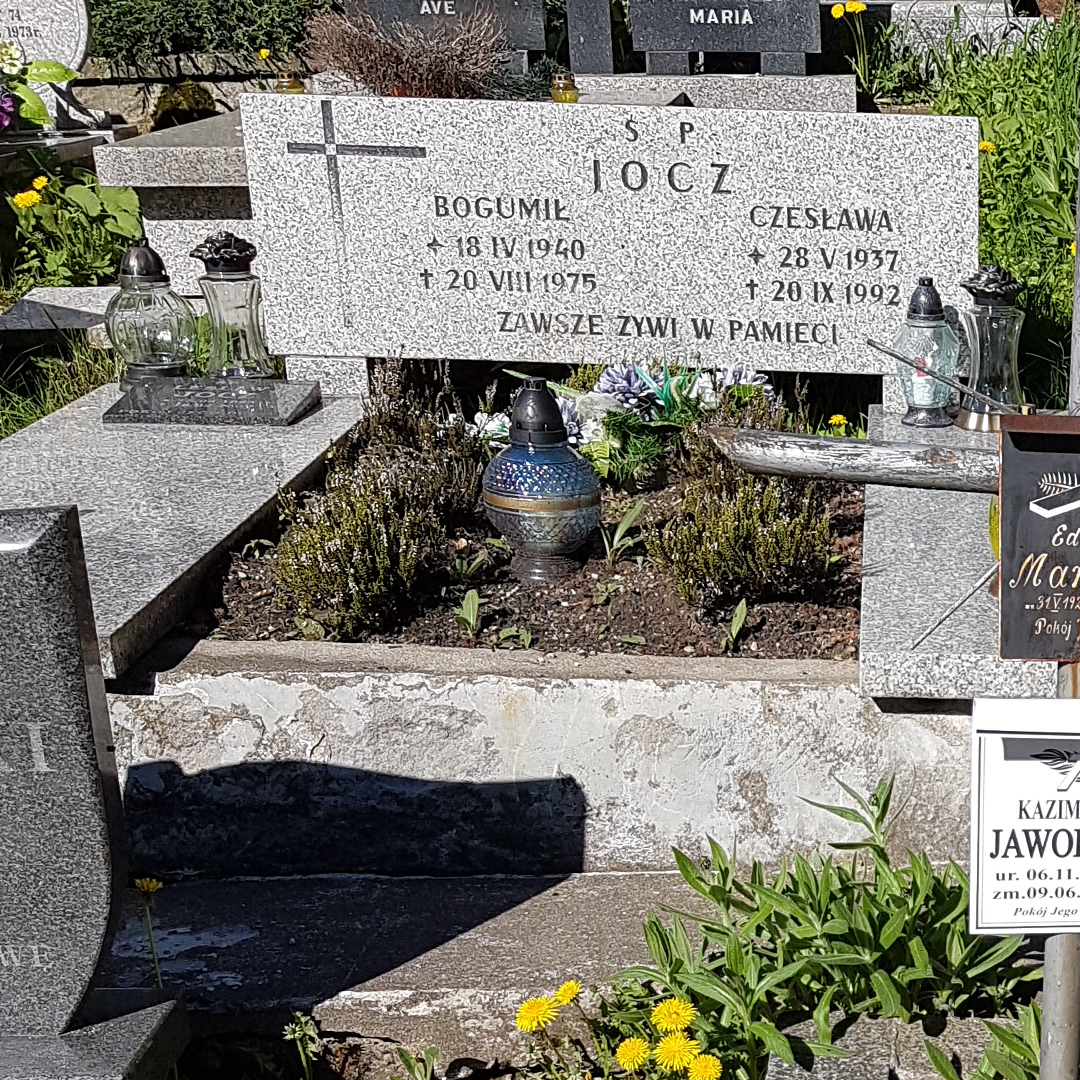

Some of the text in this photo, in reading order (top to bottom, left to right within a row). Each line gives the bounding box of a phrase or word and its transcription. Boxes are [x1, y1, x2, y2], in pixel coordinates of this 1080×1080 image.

[419, 0, 456, 15] AVE
[689, 8, 754, 26] MARIA
[589, 159, 732, 195] JOCZ
[434, 195, 571, 222] BOGUMIŁ
[749, 205, 894, 232] CZESŁAWA
[456, 235, 585, 261] 18 IV 1940
[778, 246, 899, 272] 28 V 1937
[445, 268, 598, 294] 20 VIII 1975
[771, 279, 901, 307] 20 IX 1992
[498, 310, 604, 336] ZAWSZE
[690, 317, 716, 341] W
[1034, 617, 1073, 641] Pokój
[995, 872, 1020, 882] ur.
[1013, 906, 1048, 918] Pokój
[1050, 906, 1079, 917] Jego
